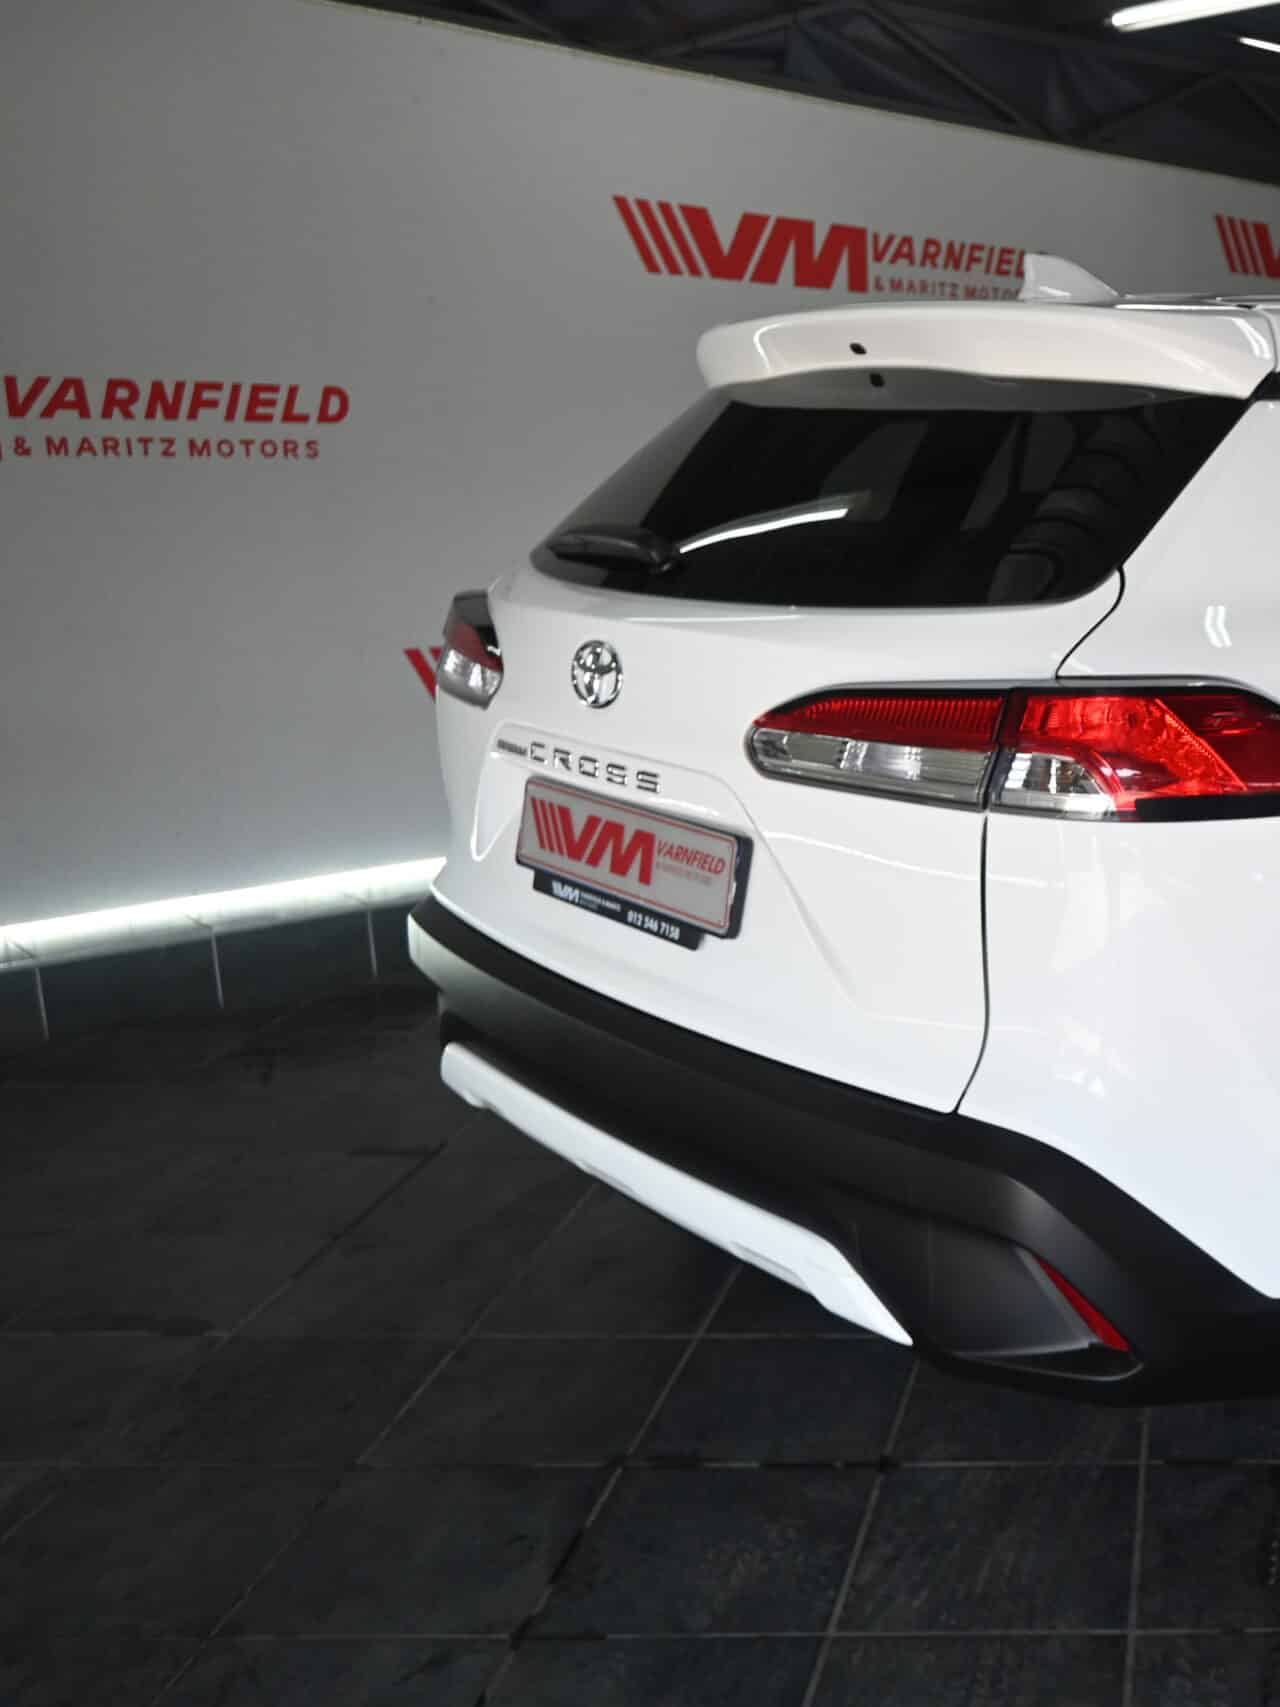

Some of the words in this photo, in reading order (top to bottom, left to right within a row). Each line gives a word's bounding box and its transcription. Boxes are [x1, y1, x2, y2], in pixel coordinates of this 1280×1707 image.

[676, 203, 869, 295] VM
[872, 231, 1025, 279] VARNFIEL
[889, 276, 960, 299] MARITZ
[964, 285, 1020, 300] MOTO
[3, 374, 350, 425] VARNFIELD
[13, 435, 32, 457] &
[45, 435, 178, 459] MARITZ
[188, 437, 321, 461] MOTORS
[529, 741, 661, 793] CROSS
[556, 805, 656, 886] VM
[656, 839, 726, 875] VARNFIELD
